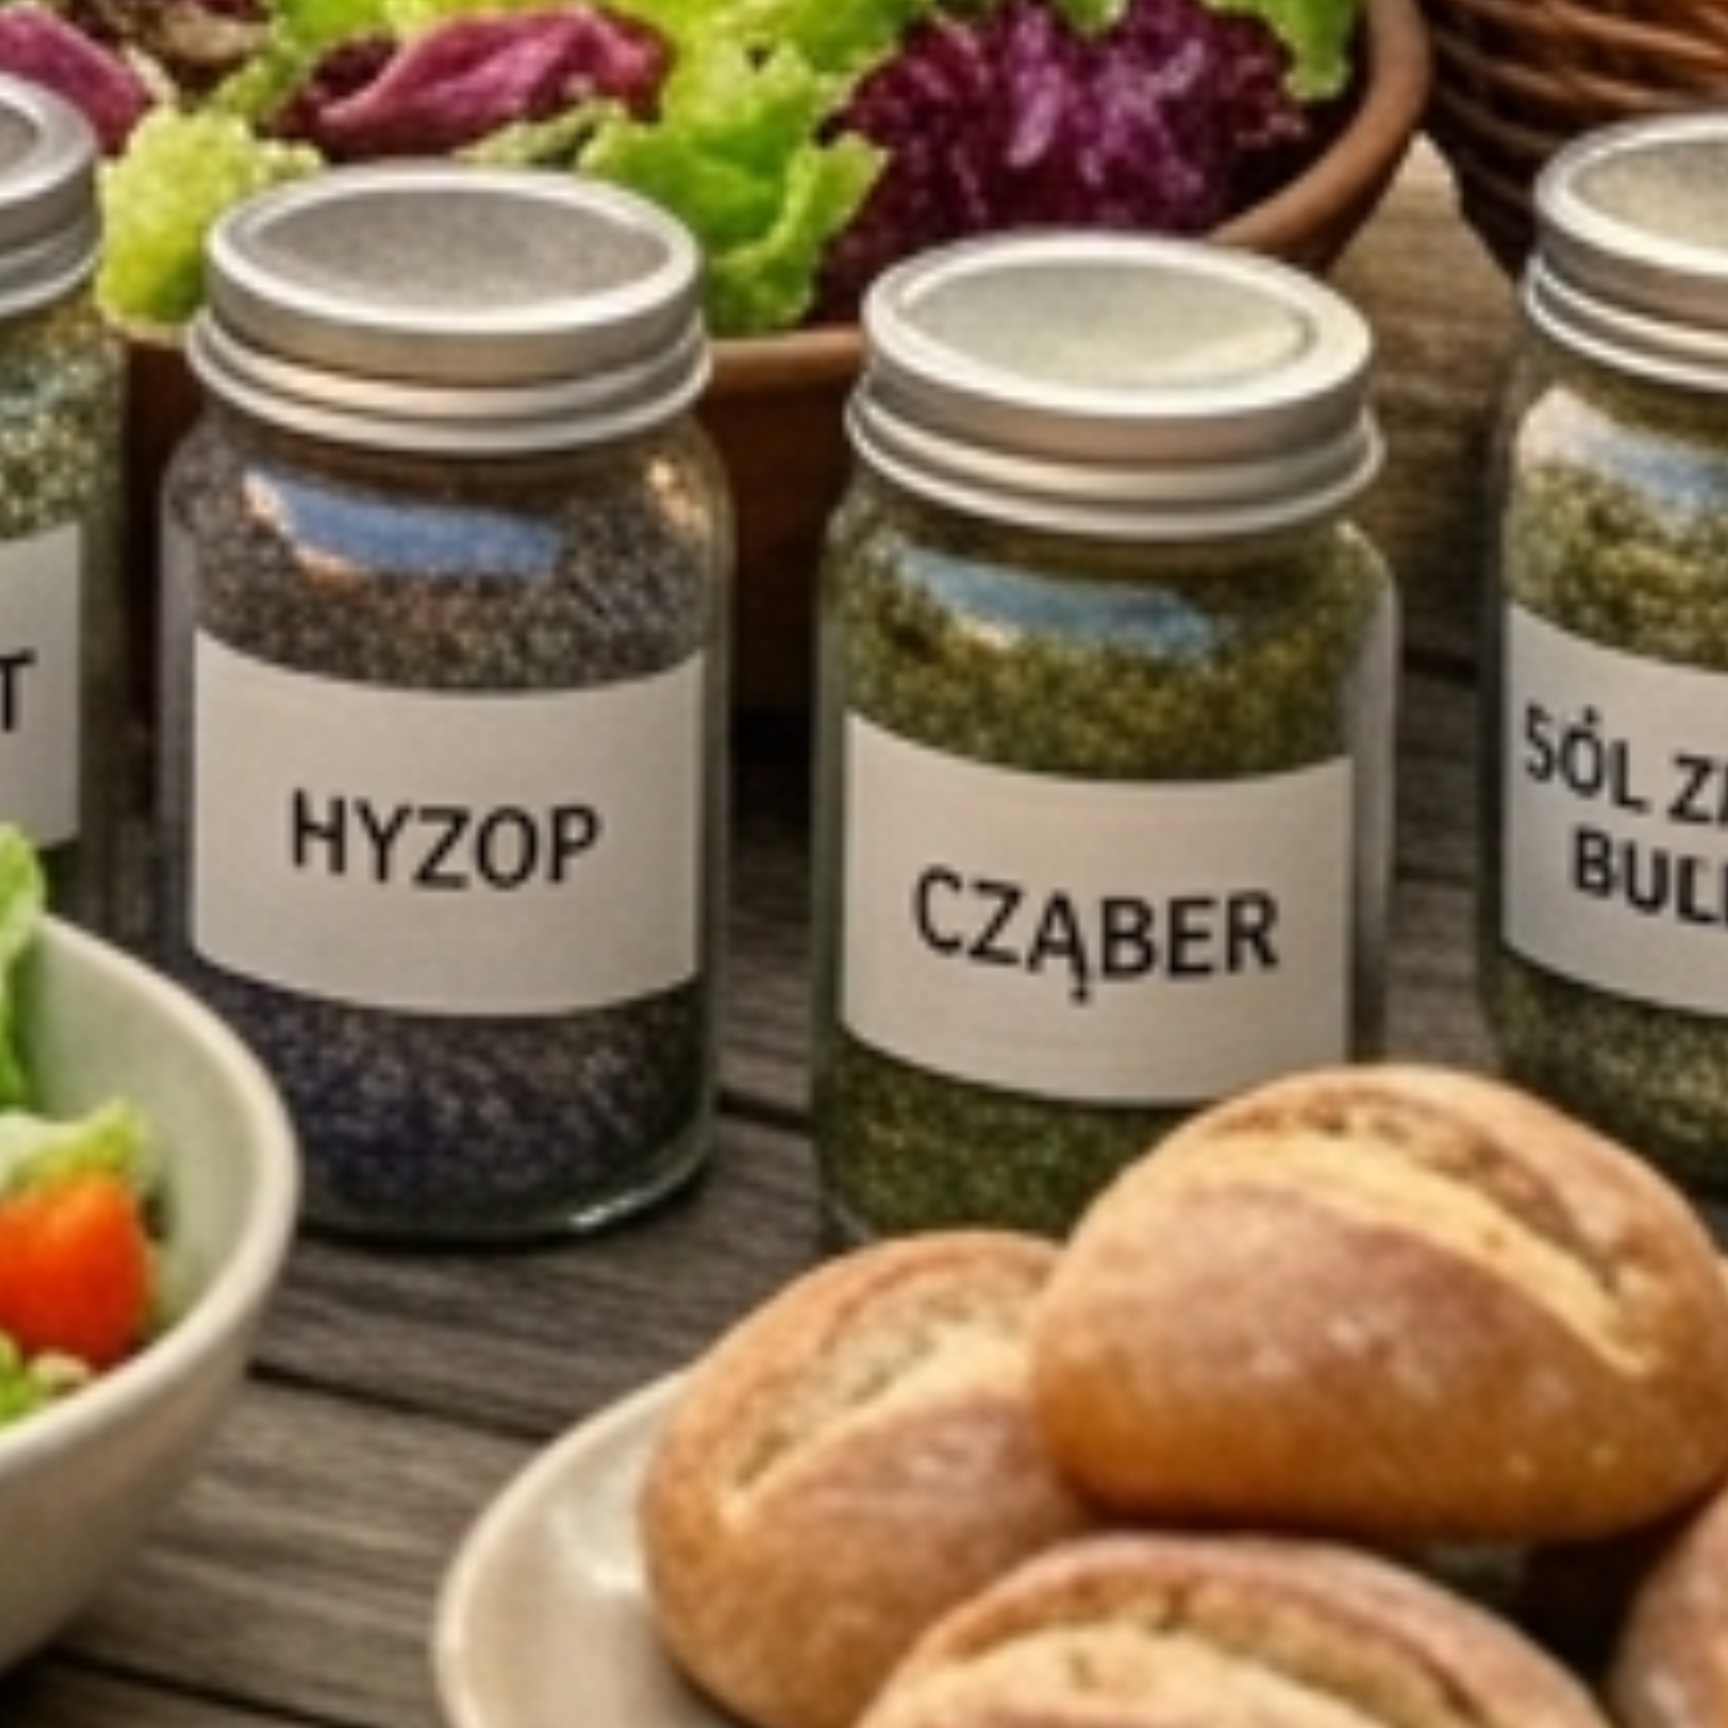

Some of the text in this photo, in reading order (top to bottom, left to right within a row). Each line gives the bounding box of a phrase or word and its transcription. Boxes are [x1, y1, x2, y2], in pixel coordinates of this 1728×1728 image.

[1524, 701, 1728, 830] SÓL Z
[291, 788, 602, 892] HYZOP
[1573, 825, 1728, 928] BUL
[913, 866, 1282, 1004] CZĄBER
